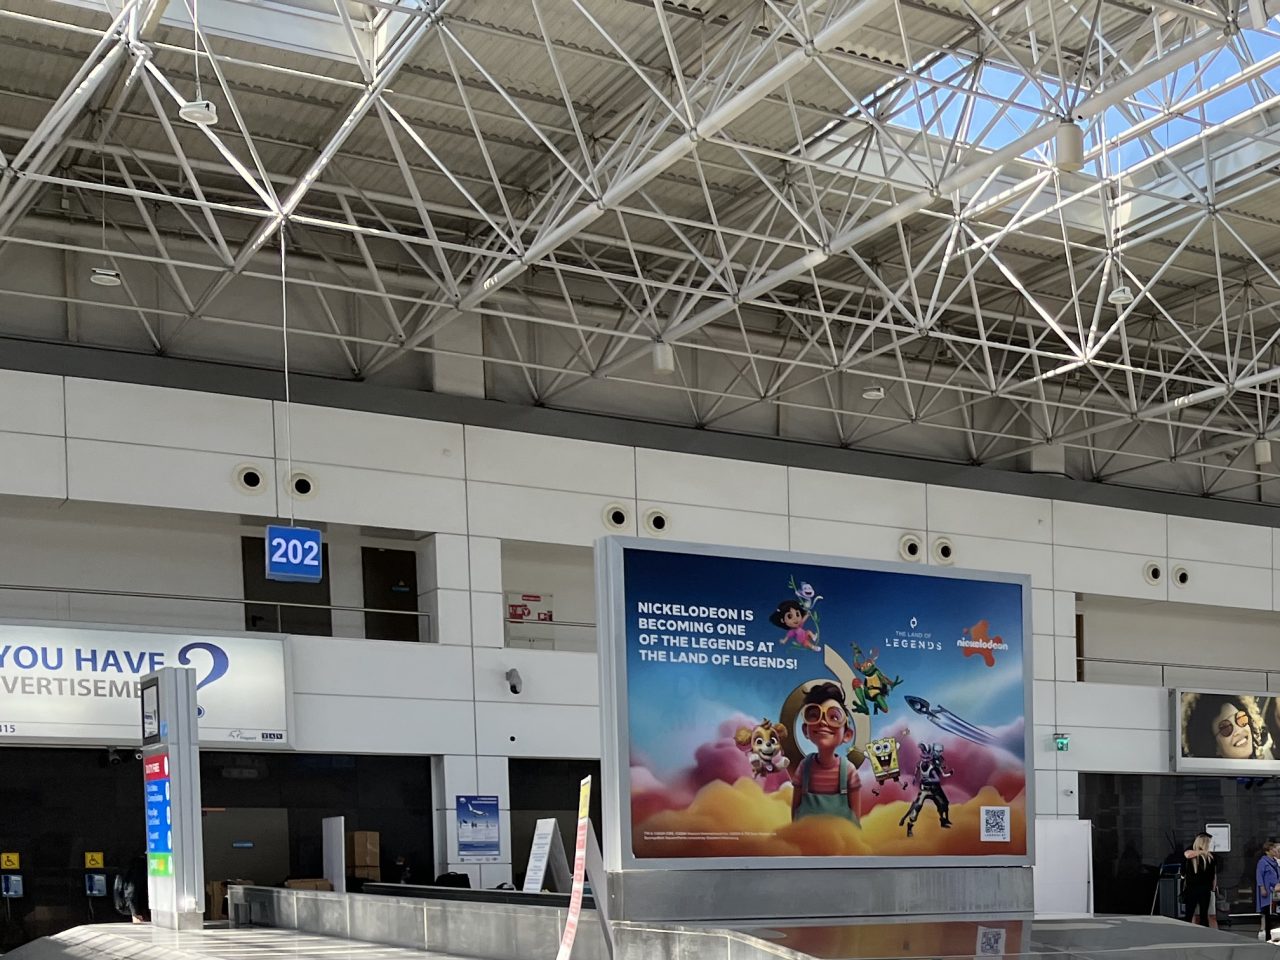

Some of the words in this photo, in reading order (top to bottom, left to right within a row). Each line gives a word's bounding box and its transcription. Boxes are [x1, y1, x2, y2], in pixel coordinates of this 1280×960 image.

[271, 537, 319, 566] 202
[638, 602, 737, 620] NICKELODEON
[741, 610, 754, 621] IS
[638, 618, 714, 634] BECOMING
[717, 624, 746, 636] ONE
[639, 634, 658, 646] OF
[661, 635, 689, 648] THE
[691, 637, 754, 652] LEGENDS
[757, 642, 775, 653] AT
[885, 638, 942, 651] LEGENDS
[956, 636, 1009, 651] nickelodeon
[0, 645, 63, 670] YOU
[75, 648, 165, 674] HAVE
[639, 650, 667, 662] THE
[670, 652, 708, 664] LAND
[711, 654, 730, 665] OF
[733, 656, 798, 670] LEGENDS!
